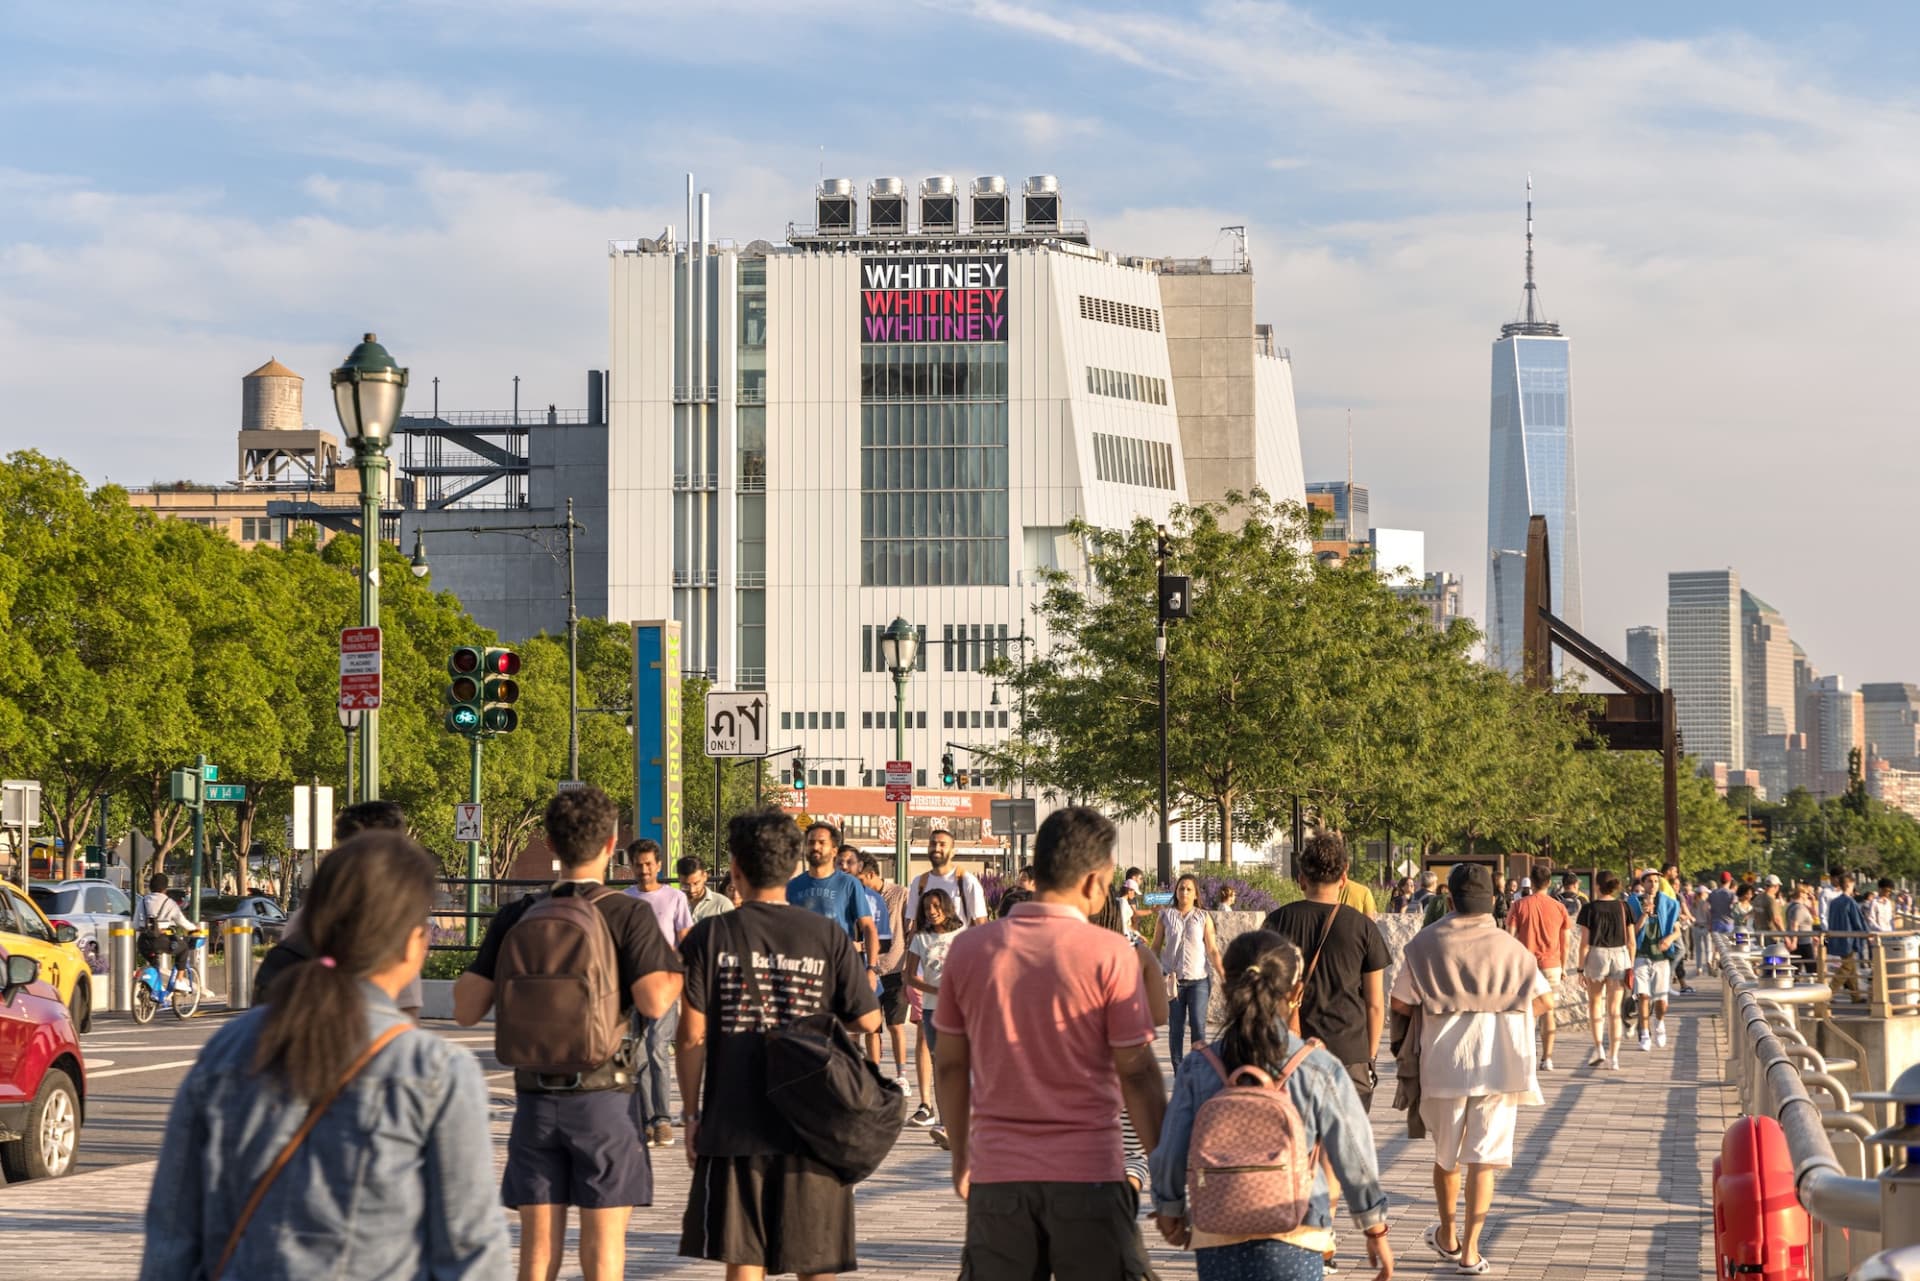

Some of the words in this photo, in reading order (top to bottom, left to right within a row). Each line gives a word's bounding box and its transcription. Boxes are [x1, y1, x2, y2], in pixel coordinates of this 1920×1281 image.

[864, 263, 1003, 288] WHITNEY
[864, 290, 1004, 315] WHITNEY
[864, 315, 1004, 341] WHITNEY
[668, 634, 680, 678] PK
[668, 687, 680, 783] RIVER
[710, 740, 736, 751] ONLY
[209, 787, 218, 799] W
[222, 787, 232, 799] 14
[717, 951, 739, 967] Giv
[751, 951, 776, 969] Back
[776, 953, 802, 972] Tour
[802, 956, 826, 976] 2017
